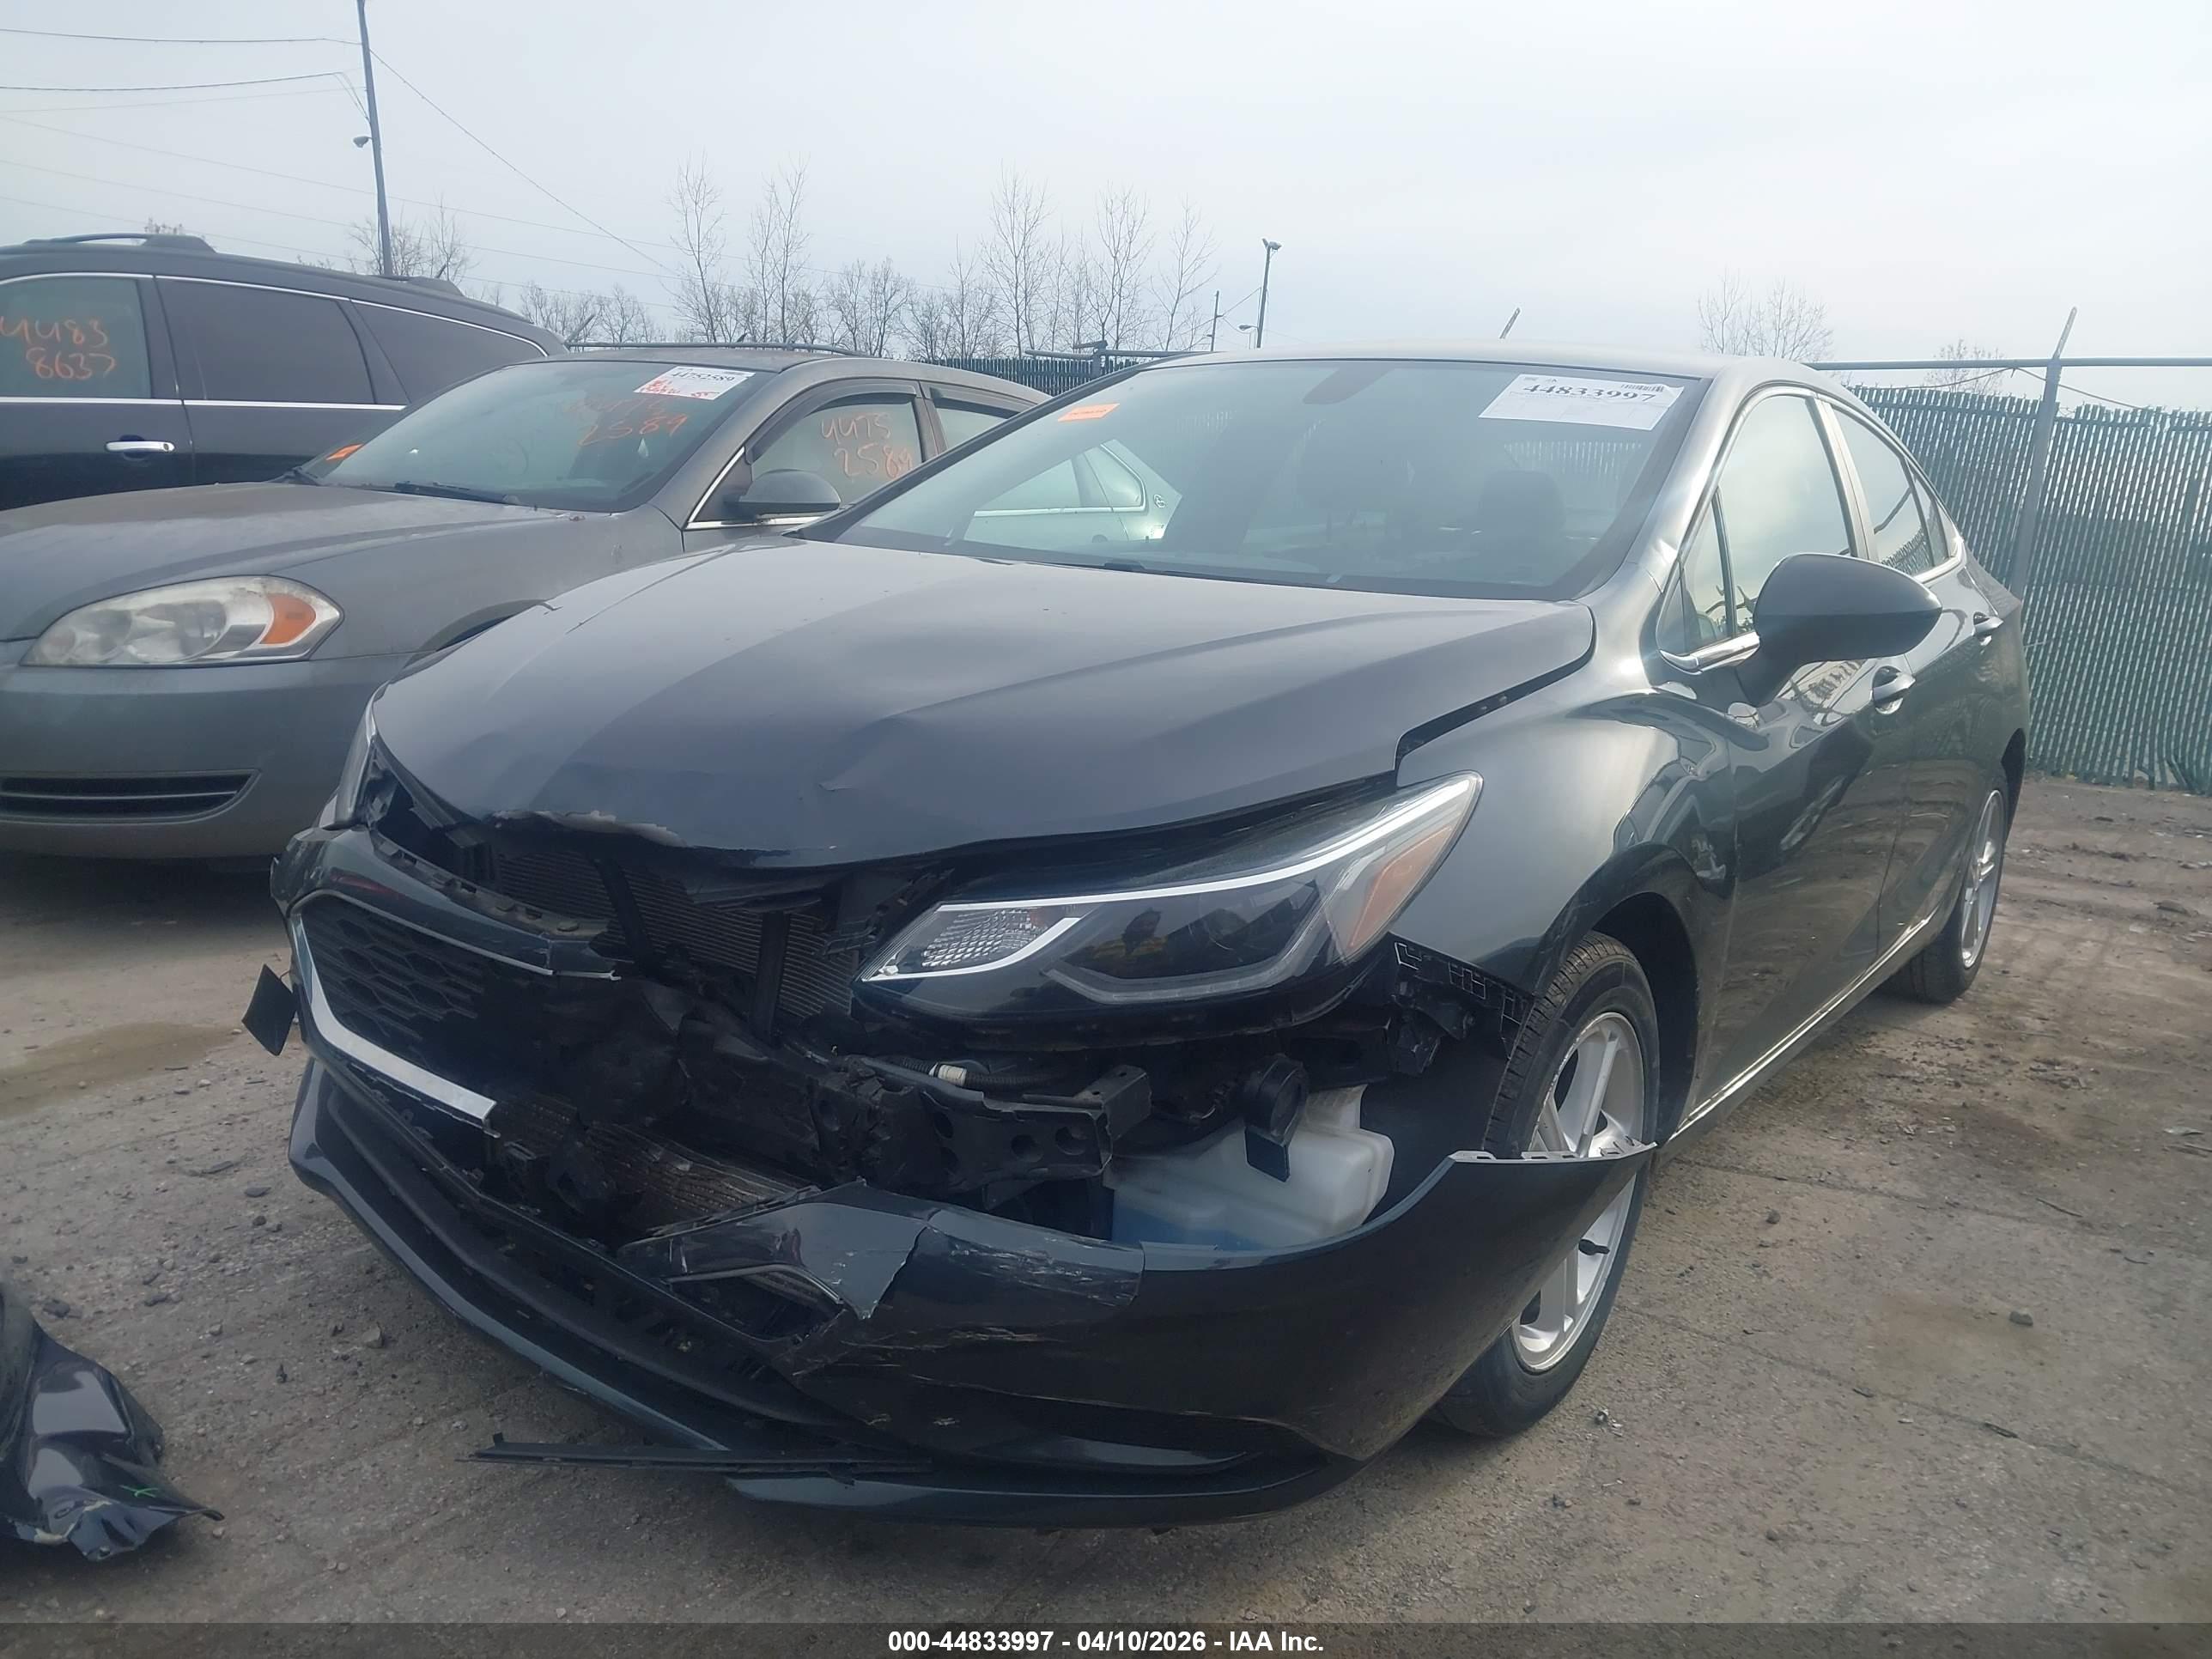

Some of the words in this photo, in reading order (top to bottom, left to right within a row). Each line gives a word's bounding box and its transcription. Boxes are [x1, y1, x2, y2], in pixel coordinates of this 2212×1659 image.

[0, 315, 108, 348] 4483
[26, 346, 117, 380] 8637
[1522, 384, 1656, 403] 44833997
